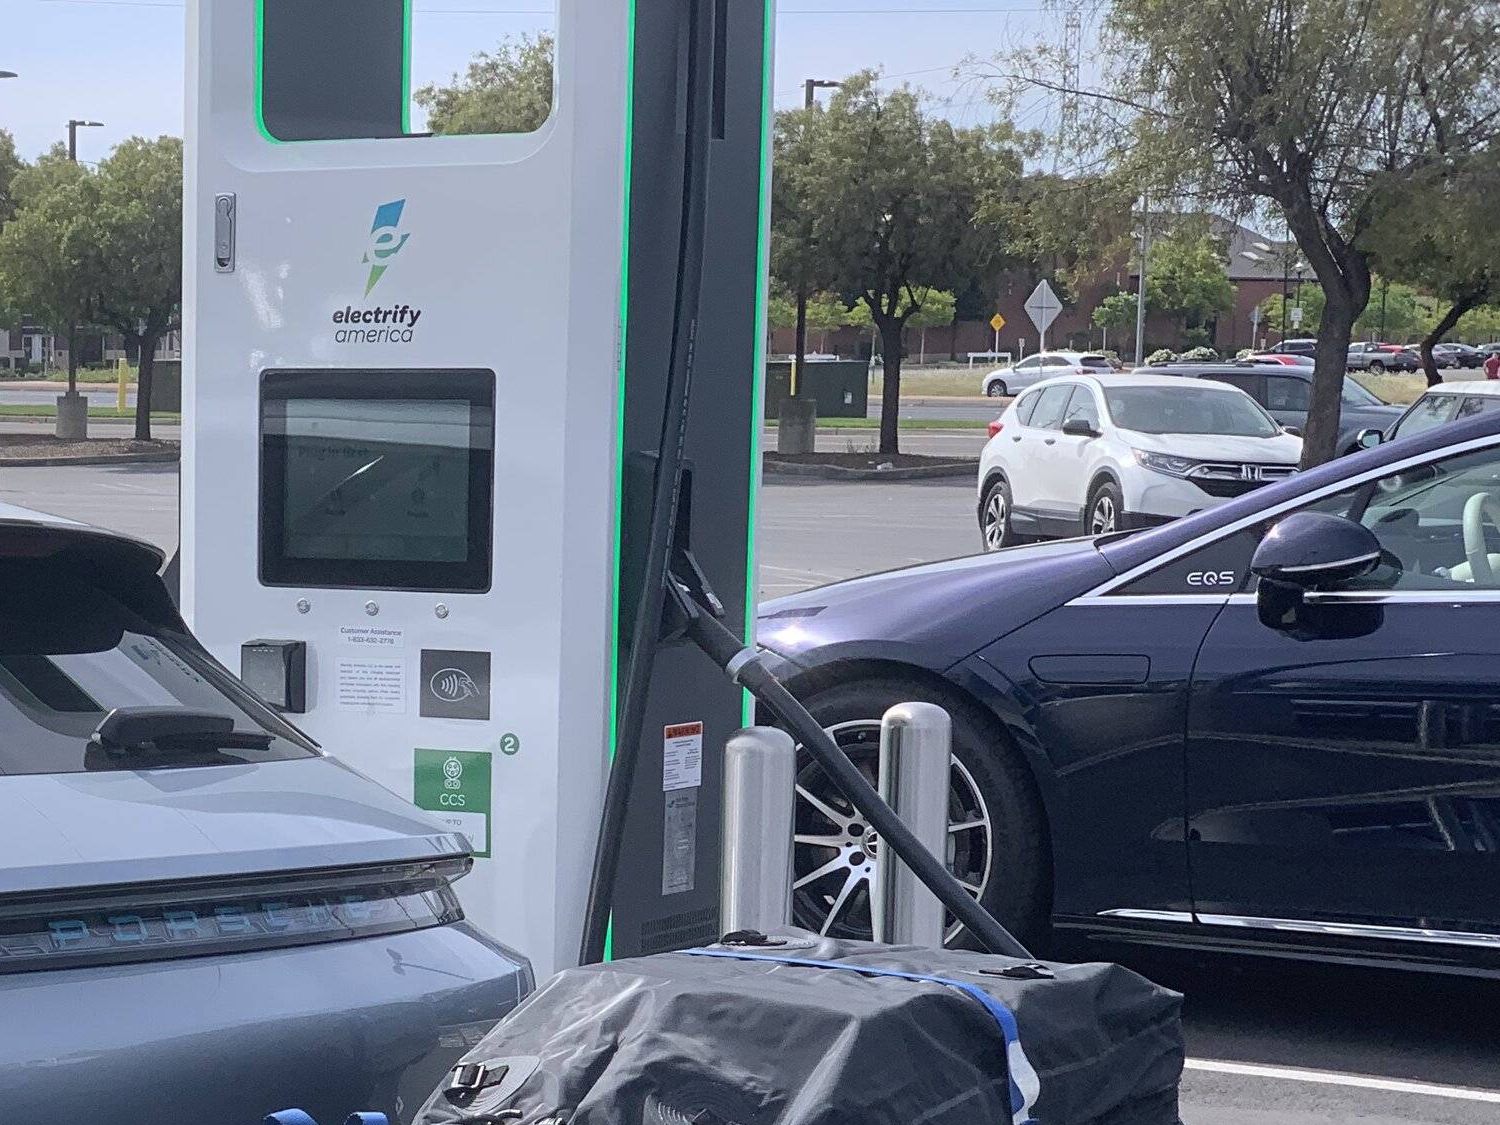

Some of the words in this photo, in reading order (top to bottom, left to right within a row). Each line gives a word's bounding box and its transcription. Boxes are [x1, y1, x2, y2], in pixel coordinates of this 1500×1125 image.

[332, 304, 422, 328] electrify
[334, 325, 414, 344] america
[1187, 571, 1235, 586] EQS
[340, 627, 370, 635] Customer
[370, 628, 402, 637] Assistance
[504, 737, 515, 752] 2
[440, 793, 466, 806] CCS
[49, 893, 385, 948] PORSCHE
